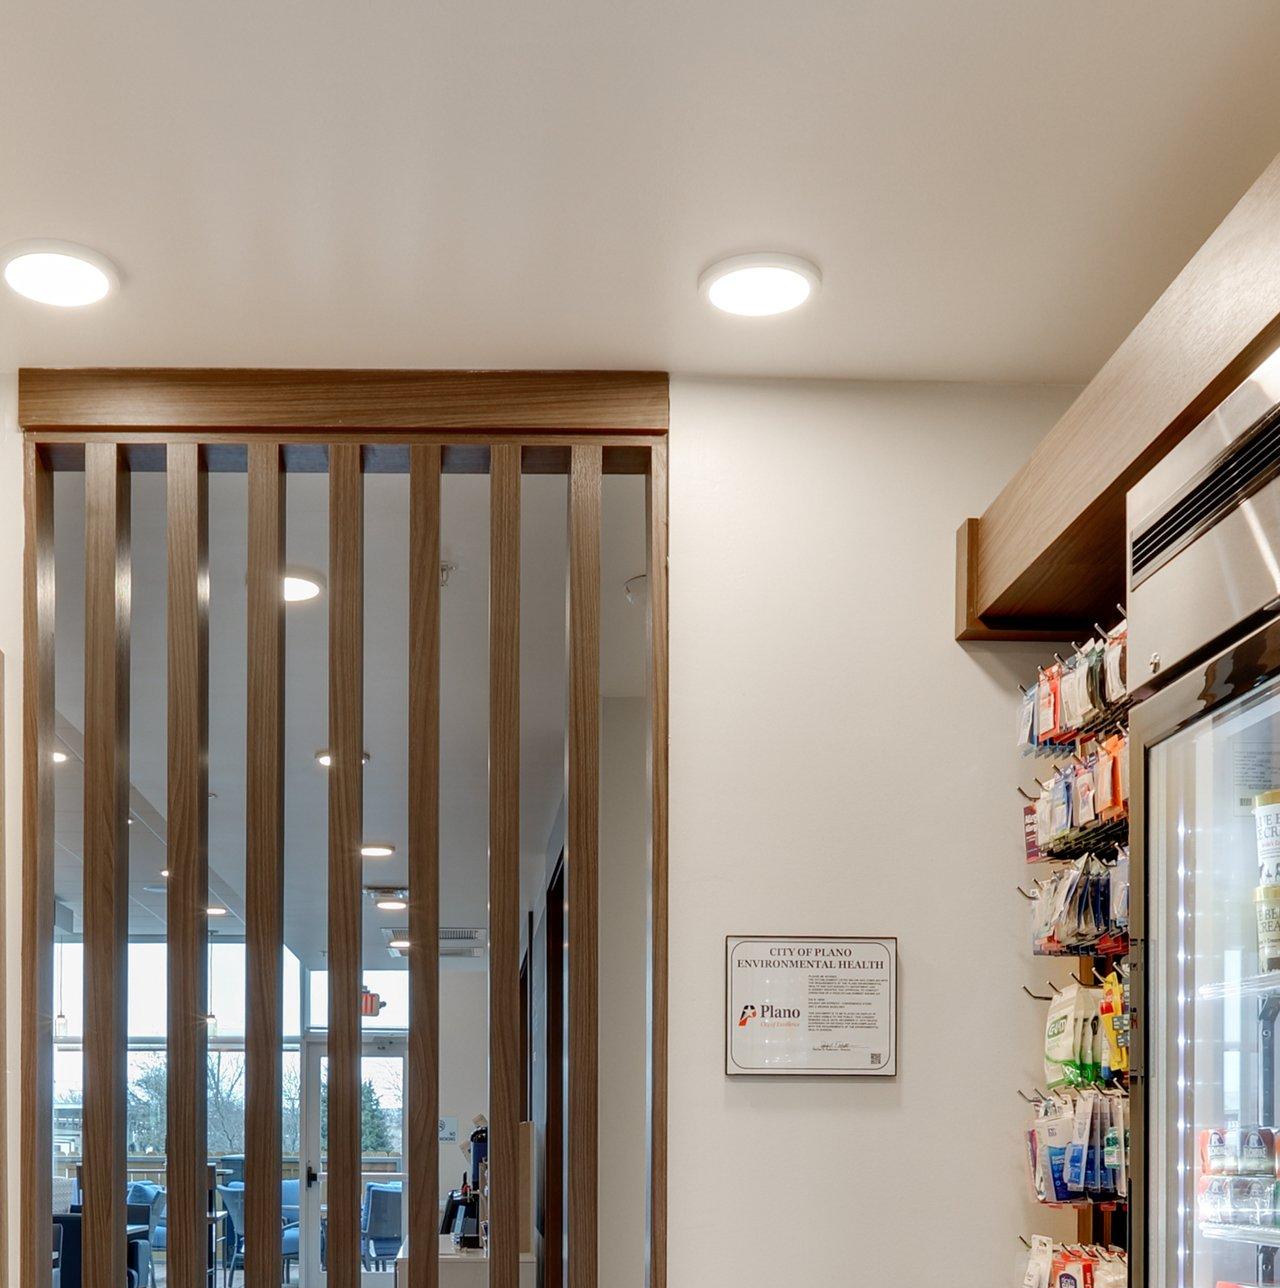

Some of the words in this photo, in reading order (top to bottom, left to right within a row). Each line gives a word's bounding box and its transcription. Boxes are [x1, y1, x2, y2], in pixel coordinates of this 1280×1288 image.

[769, 948, 796, 957] CITY
[797, 948, 813, 957] OF
[814, 948, 852, 957] PLANO
[737, 960, 836, 969] ENVIRONMENTAL
[838, 960, 884, 970] HEALTH
[760, 1004, 801, 1019] Plano
